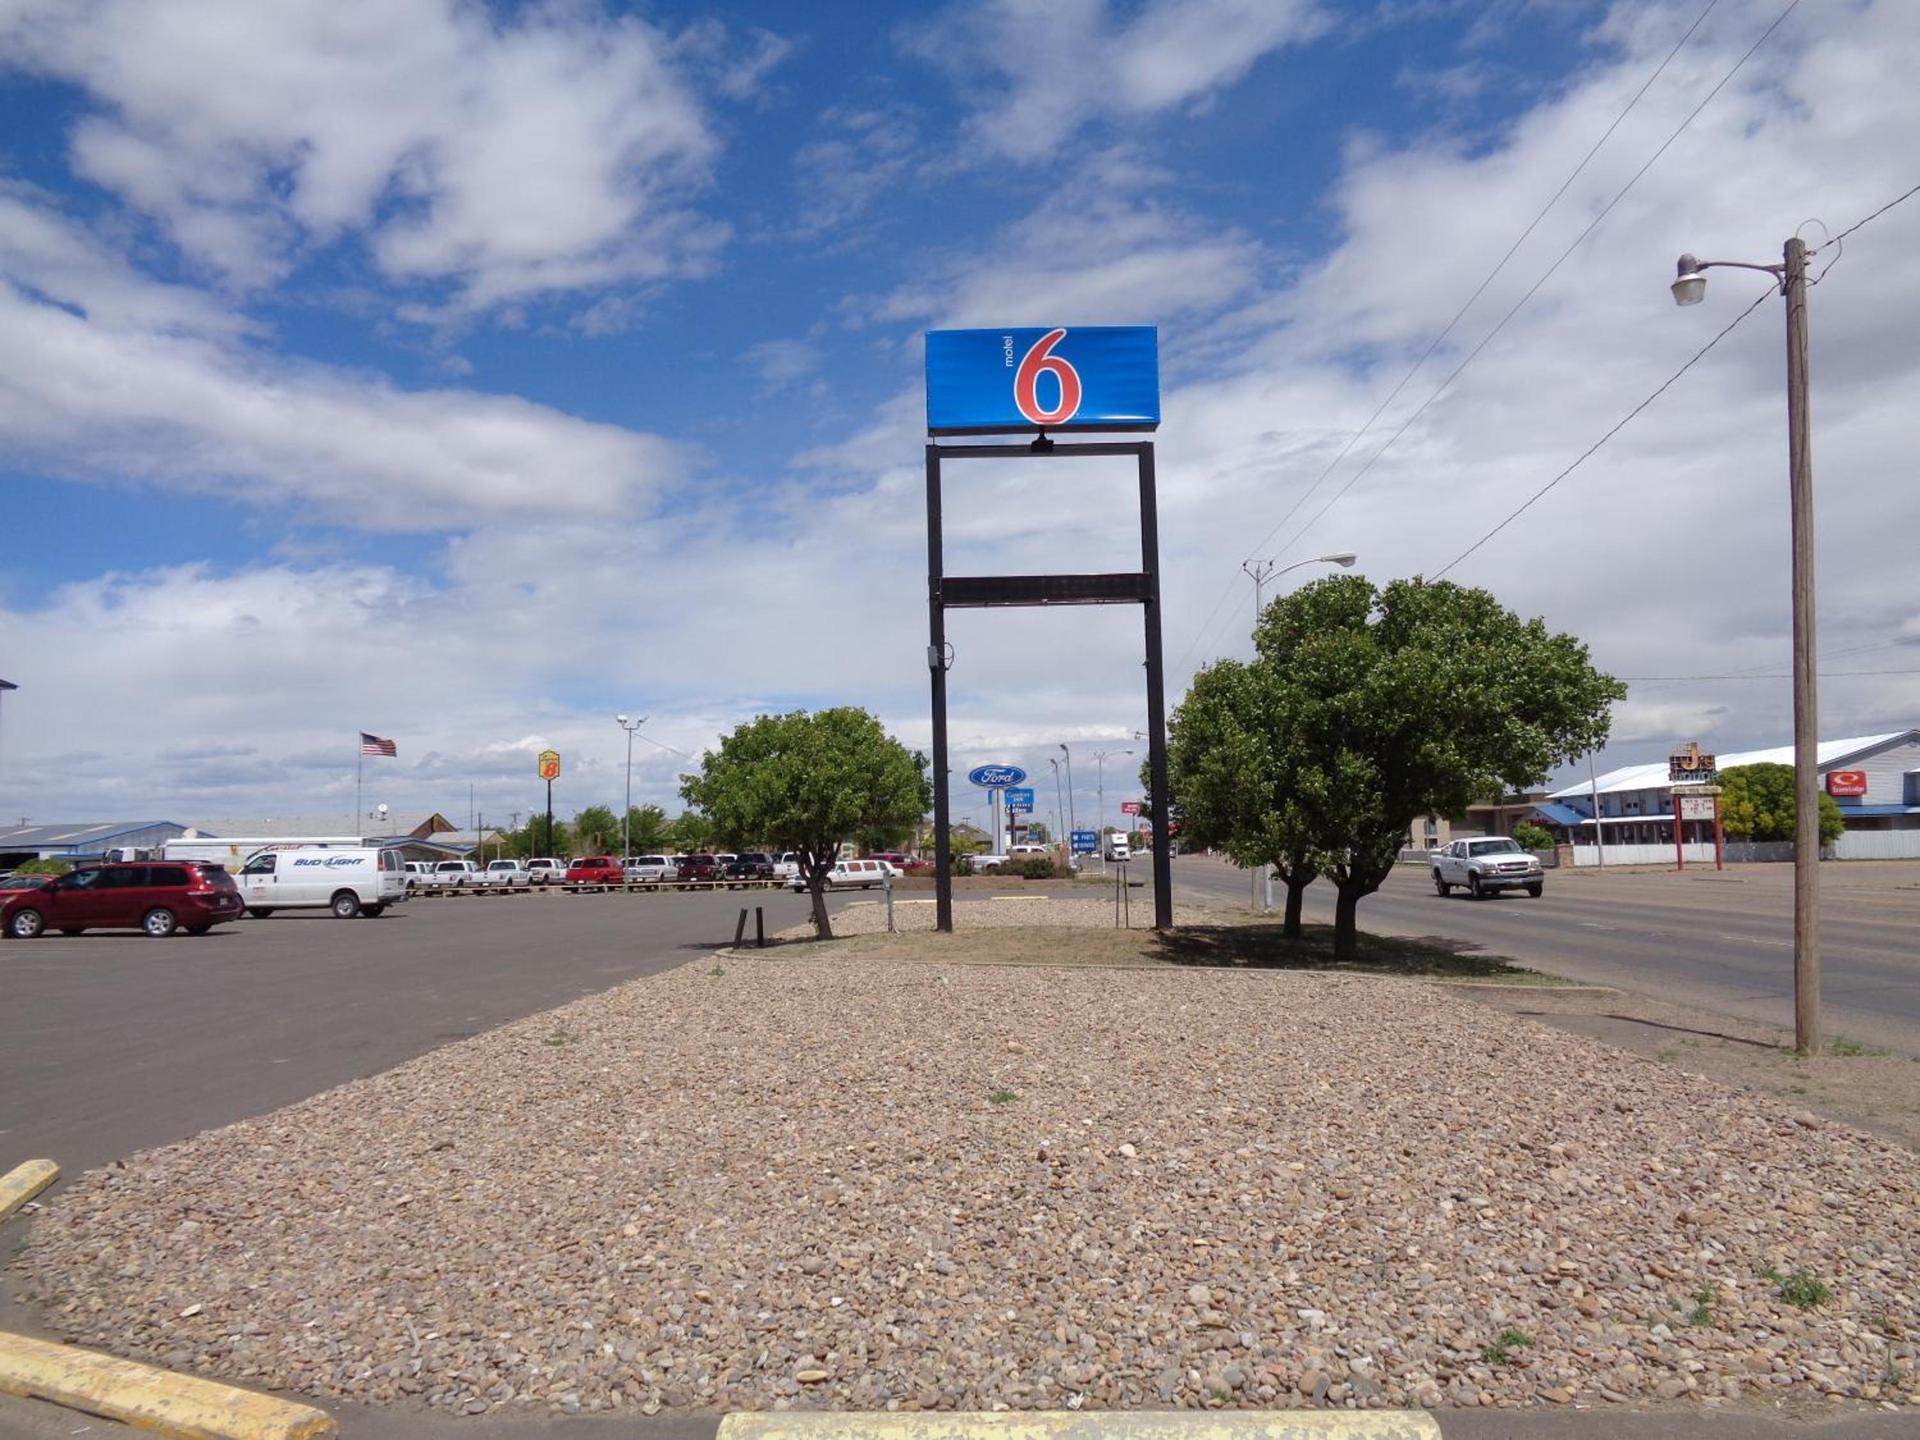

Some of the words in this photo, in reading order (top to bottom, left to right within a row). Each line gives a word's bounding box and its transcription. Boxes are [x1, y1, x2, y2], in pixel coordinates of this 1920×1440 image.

[1003, 335, 1013, 367] motel
[1014, 328, 1082, 424] 6
[543, 762, 557, 777] 8
[980, 768, 1015, 783] Ford
[293, 857, 322, 867] BUD
[327, 857, 366, 867] LIGHT
